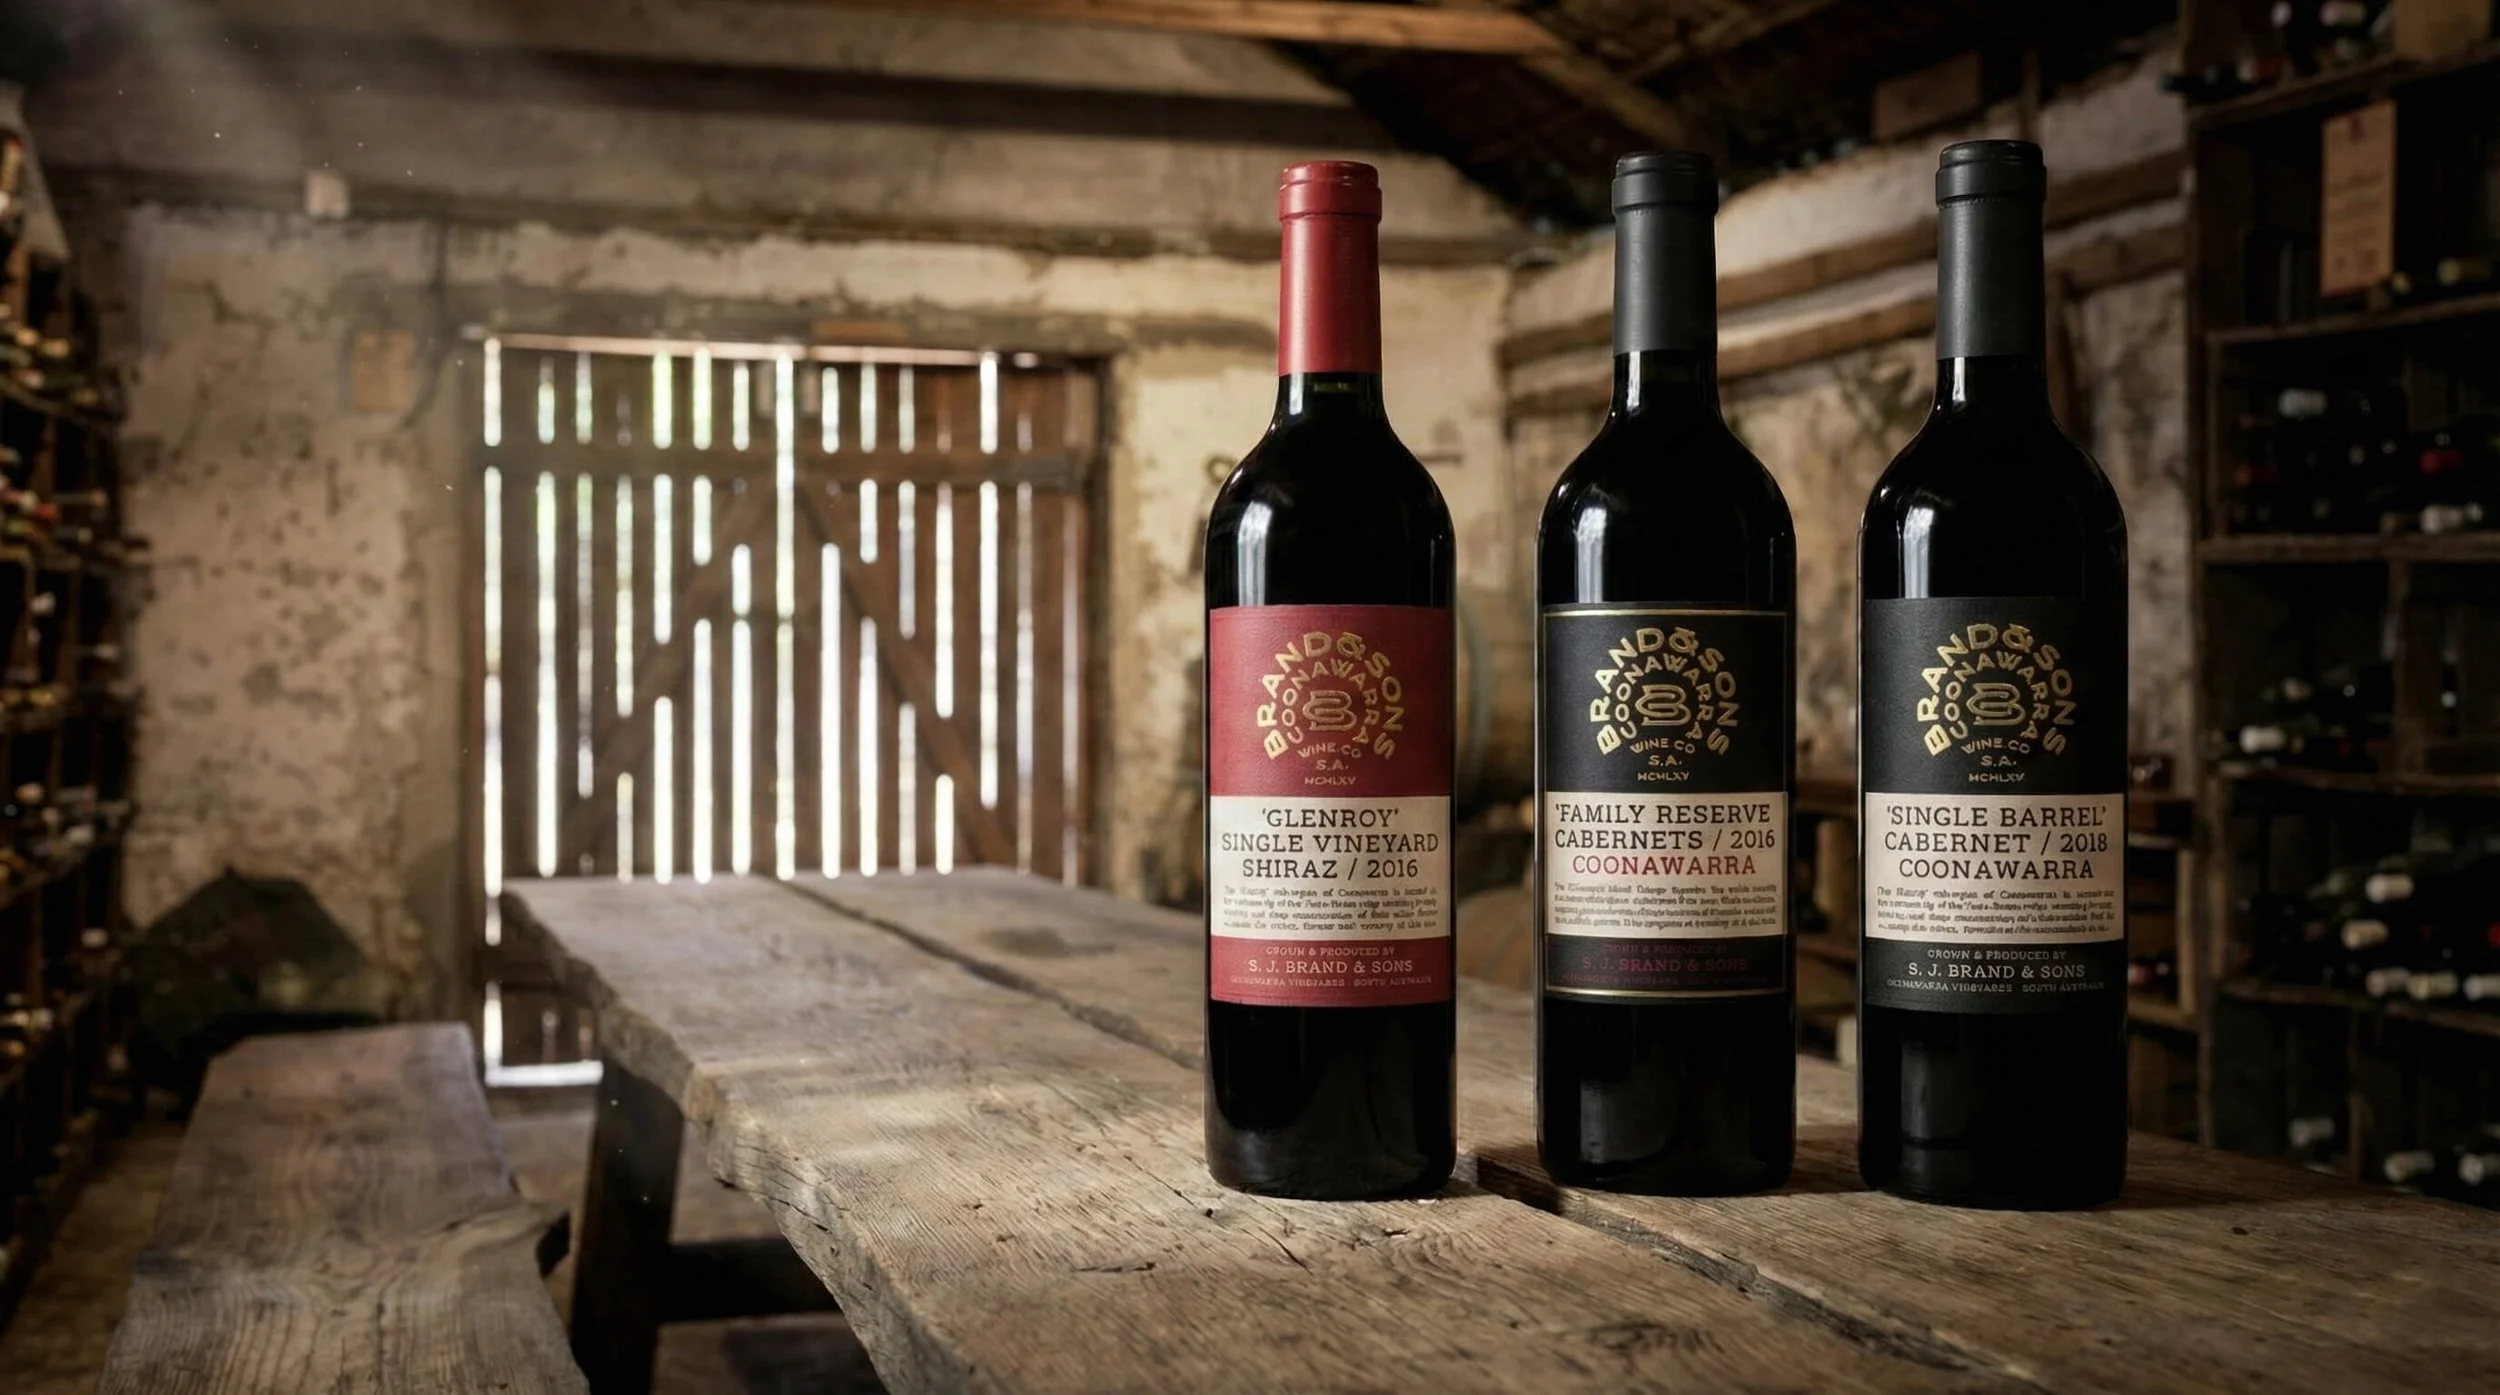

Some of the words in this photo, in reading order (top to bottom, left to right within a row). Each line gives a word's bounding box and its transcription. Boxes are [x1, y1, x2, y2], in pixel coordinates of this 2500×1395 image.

[1656, 804, 1770, 824] RESERVE
[1221, 833, 1303, 852] SINGLE
[1312, 833, 1438, 853] VINEYARD
[1555, 829, 1703, 849] CABERNETS
[1712, 829, 1722, 851] /
[1730, 829, 1775, 849] 2016
[1885, 832, 2030, 851] CABERNET
[2040, 830, 2051, 855] /
[2060, 832, 2107, 851] 2018
[1242, 859, 1338, 878] SHIRAZ
[1347, 858, 1358, 880] /
[1367, 859, 1418, 878] 2016
[1573, 855, 1756, 875] COONAWARRA
[1899, 858, 2094, 879] COONAWARRA
[1285, 961, 1348, 974] BRAND
[1353, 961, 1366, 973] &
[1371, 960, 1413, 973] SONS
[1618, 958, 1681, 971] BRAND
[1687, 959, 1698, 971] &
[1705, 958, 1747, 970] SONS
[1948, 963, 2015, 978] BRAND
[2021, 964, 2034, 978] &
[2040, 964, 2085, 978] SONS
